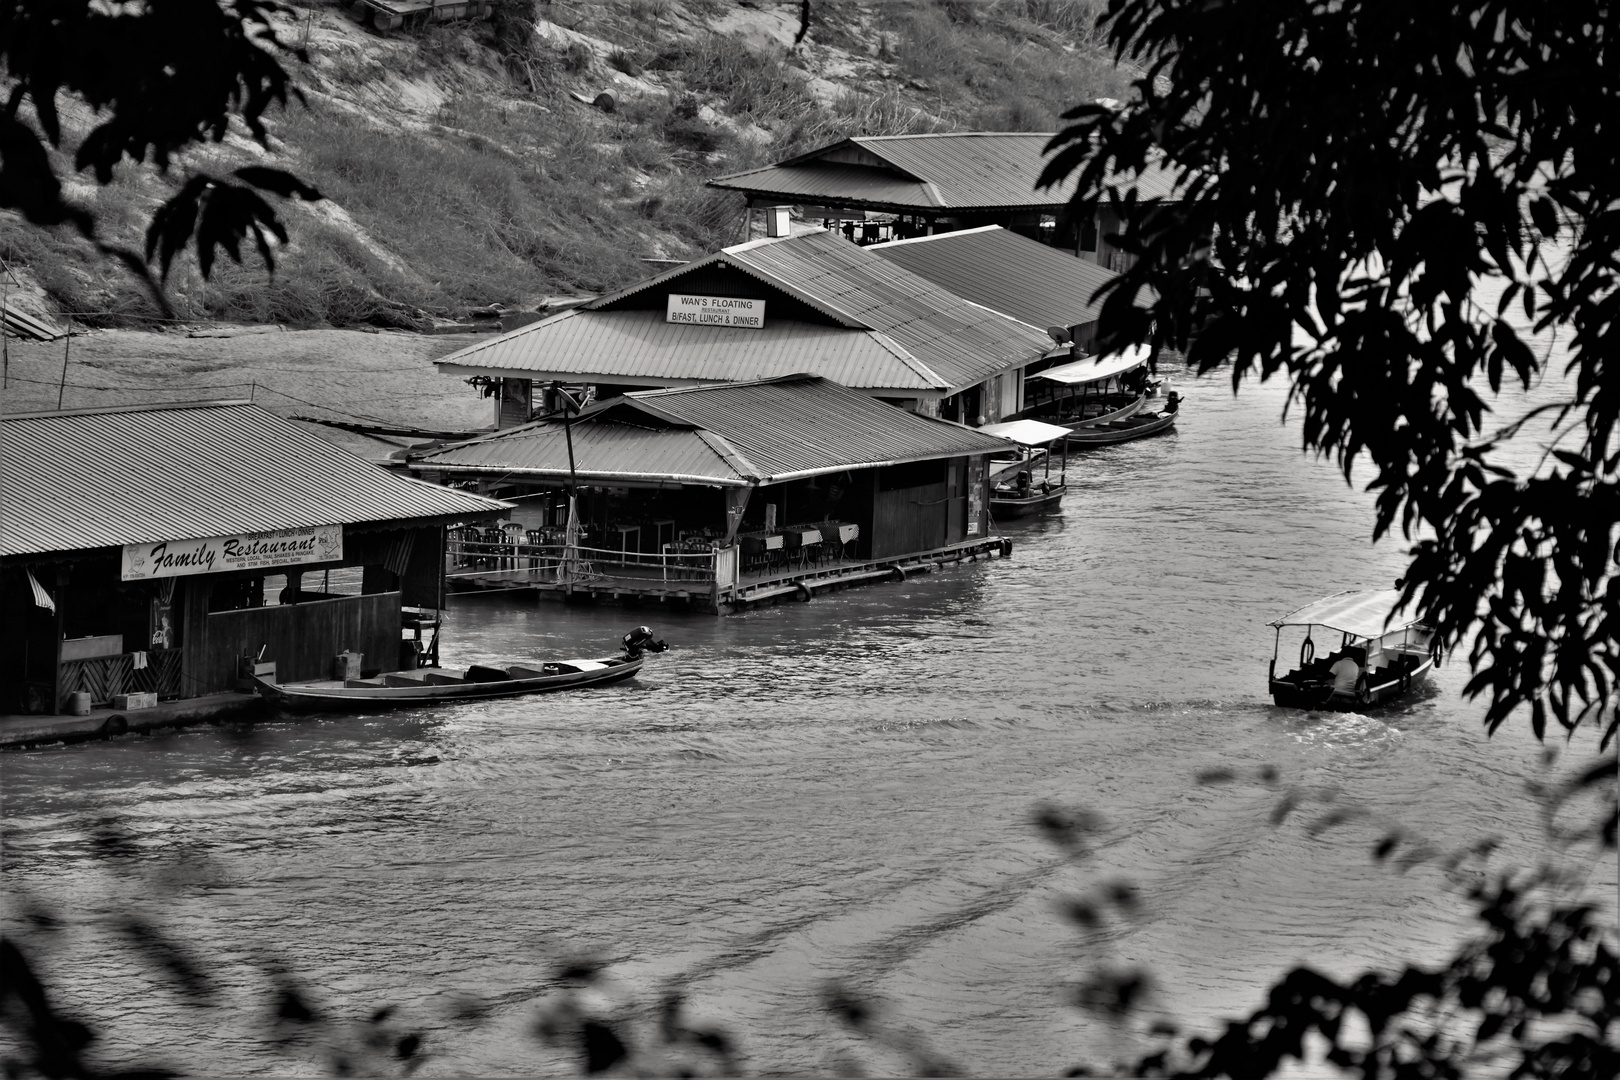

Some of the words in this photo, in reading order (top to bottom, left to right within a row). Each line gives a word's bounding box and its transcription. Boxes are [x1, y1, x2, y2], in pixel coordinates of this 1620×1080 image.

[681, 297, 708, 307] WAN'S
[711, 299, 753, 309] FLOATING
[700, 314, 723, 324] LUNCH
[725, 315, 730, 324] &
[733, 316, 759, 326] DINNER
[248, 531, 275, 541] BREAKFAST
[278, 529, 295, 538] LUNCH
[298, 527, 315, 536] DINNER
[150, 542, 216, 575] Family
[222, 536, 316, 559] Restaurant
